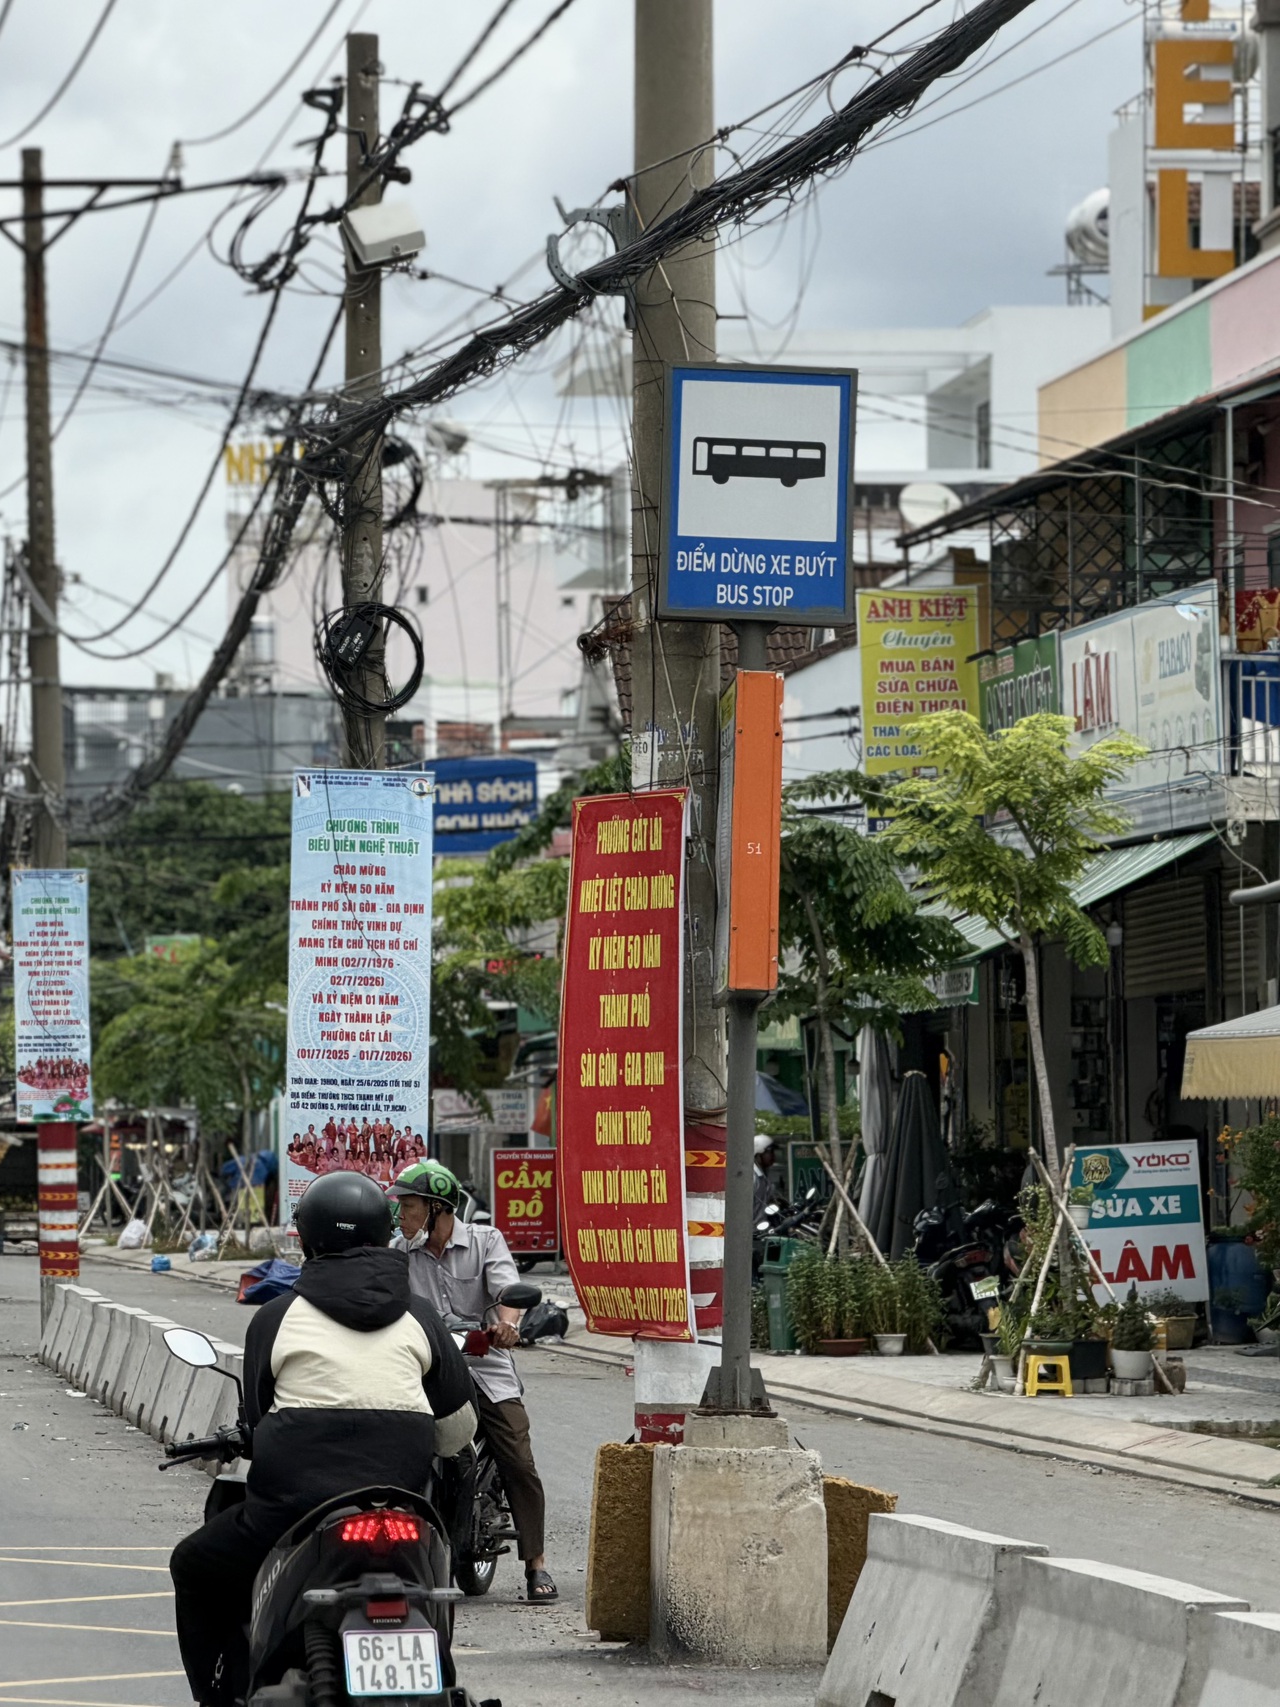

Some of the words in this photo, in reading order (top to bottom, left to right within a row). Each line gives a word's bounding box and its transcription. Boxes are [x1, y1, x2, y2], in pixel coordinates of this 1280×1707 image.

[677, 543, 715, 572] ĐIỂM
[721, 547, 766, 575] DỪNG
[770, 555, 790, 576] XE
[796, 552, 837, 577] BUÝT
[717, 584, 748, 604] BUS
[753, 585, 794, 606] STOP
[867, 598, 911, 618] ANH
[919, 593, 968, 626] KIỆT
[883, 630, 952, 648] Chuyên
[880, 661, 915, 673] MUA
[921, 658, 954, 672] BÁN
[877, 677, 910, 693] SỬA
[915, 678, 959, 692] CHỮA
[1072, 640, 1113, 733] LÂM
[876, 699, 914, 716] ĐIỆN
[873, 726, 900, 737] THAY
[867, 744, 890, 757] CÁC
[477, 777, 533, 802] SÁCH
[326, 819, 367, 833] CHƯƠNG
[370, 818, 399, 834] TRÌNH
[596, 815, 630, 854] PHƯỜNG
[632, 813, 648, 852] CÁT
[650, 812, 662, 851] LÁI
[359, 838, 385, 856] NGHỆ
[389, 840, 419, 857] THUẬT
[747, 842, 762, 855] 51
[334, 863, 356, 876] CHÀO
[359, 864, 386, 876] MỪNG
[335, 882, 356, 895] NIỆM
[360, 883, 372, 894] 50
[375, 883, 394, 895] NĂM
[579, 873, 604, 919] NHIỆT
[605, 872, 623, 918] LIỆT
[624, 870, 648, 911] CHÀO
[651, 870, 674, 909] MỪNG
[291, 899, 318, 912] THÀNH
[322, 899, 340, 912] PHỐ
[342, 900, 356, 913] SÀI
[360, 900, 376, 913] GÒN
[387, 903, 401, 913] GIA
[404, 903, 424, 915] ĐỊNH
[312, 917, 337, 930] CHÍNH
[367, 921, 387, 931] VINH
[390, 921, 402, 934] DỰ
[299, 938, 325, 948] MANG
[328, 937, 343, 949] TÊN
[346, 936, 363, 949] CHỦ
[367, 938, 385, 951] TỊCH
[403, 937, 418, 950] CHÍ
[589, 928, 602, 970] KỶ
[603, 930, 625, 976] NIỆM
[628, 936, 640, 969] 50
[643, 929, 661, 969] NĂM
[315, 956, 338, 967] MINH
[341, 957, 394, 968] (02/7/1976
[330, 976, 384, 987] 02/7/2026)
[312, 992, 324, 1004] VÀ
[340, 993, 362, 1008] NIỆM
[365, 994, 376, 1005] 01
[379, 993, 399, 1006] NĂM
[599, 989, 628, 1028] THÀNH
[631, 982, 650, 1028] PHỐ
[319, 1009, 342, 1023] NGÀY
[345, 1010, 372, 1024] THÀNH
[375, 1011, 391, 1027] LẬP
[321, 1027, 356, 1042] PHƯỜNG
[359, 1030, 375, 1042] CÁT
[379, 1030, 392, 1043] LÁI
[297, 1049, 349, 1060] (01/7/2025
[359, 1050, 412, 1062] 01/7/2026)
[580, 1049, 596, 1087] SÀI
[599, 1048, 617, 1087] GÒN
[624, 1052, 642, 1086] GIA
[644, 1051, 664, 1092] ĐỊNH
[596, 1106, 624, 1146] CHÍNH
[626, 1106, 651, 1145] THỨC
[498, 1161, 553, 1188] CẦM
[582, 1170, 604, 1204] VINH
[606, 1164, 620, 1210] DỰ
[621, 1169, 648, 1204] MANG
[650, 1164, 668, 1204] TÊN
[507, 1190, 544, 1218] ĐỒ
[1092, 1194, 1143, 1219] SỬA
[1149, 1195, 1181, 1215] XE
[578, 1221, 598, 1263] CHỦ
[598, 1229, 620, 1269] TỊCH
[620, 1218, 634, 1263] HỒ
[636, 1224, 653, 1262] CHÍ
[654, 1229, 678, 1263] MINH
[1090, 1240, 1196, 1284] LÂM
[358, 1636, 424, 1661] 66-LA
[356, 1663, 433, 1691] 148.15
